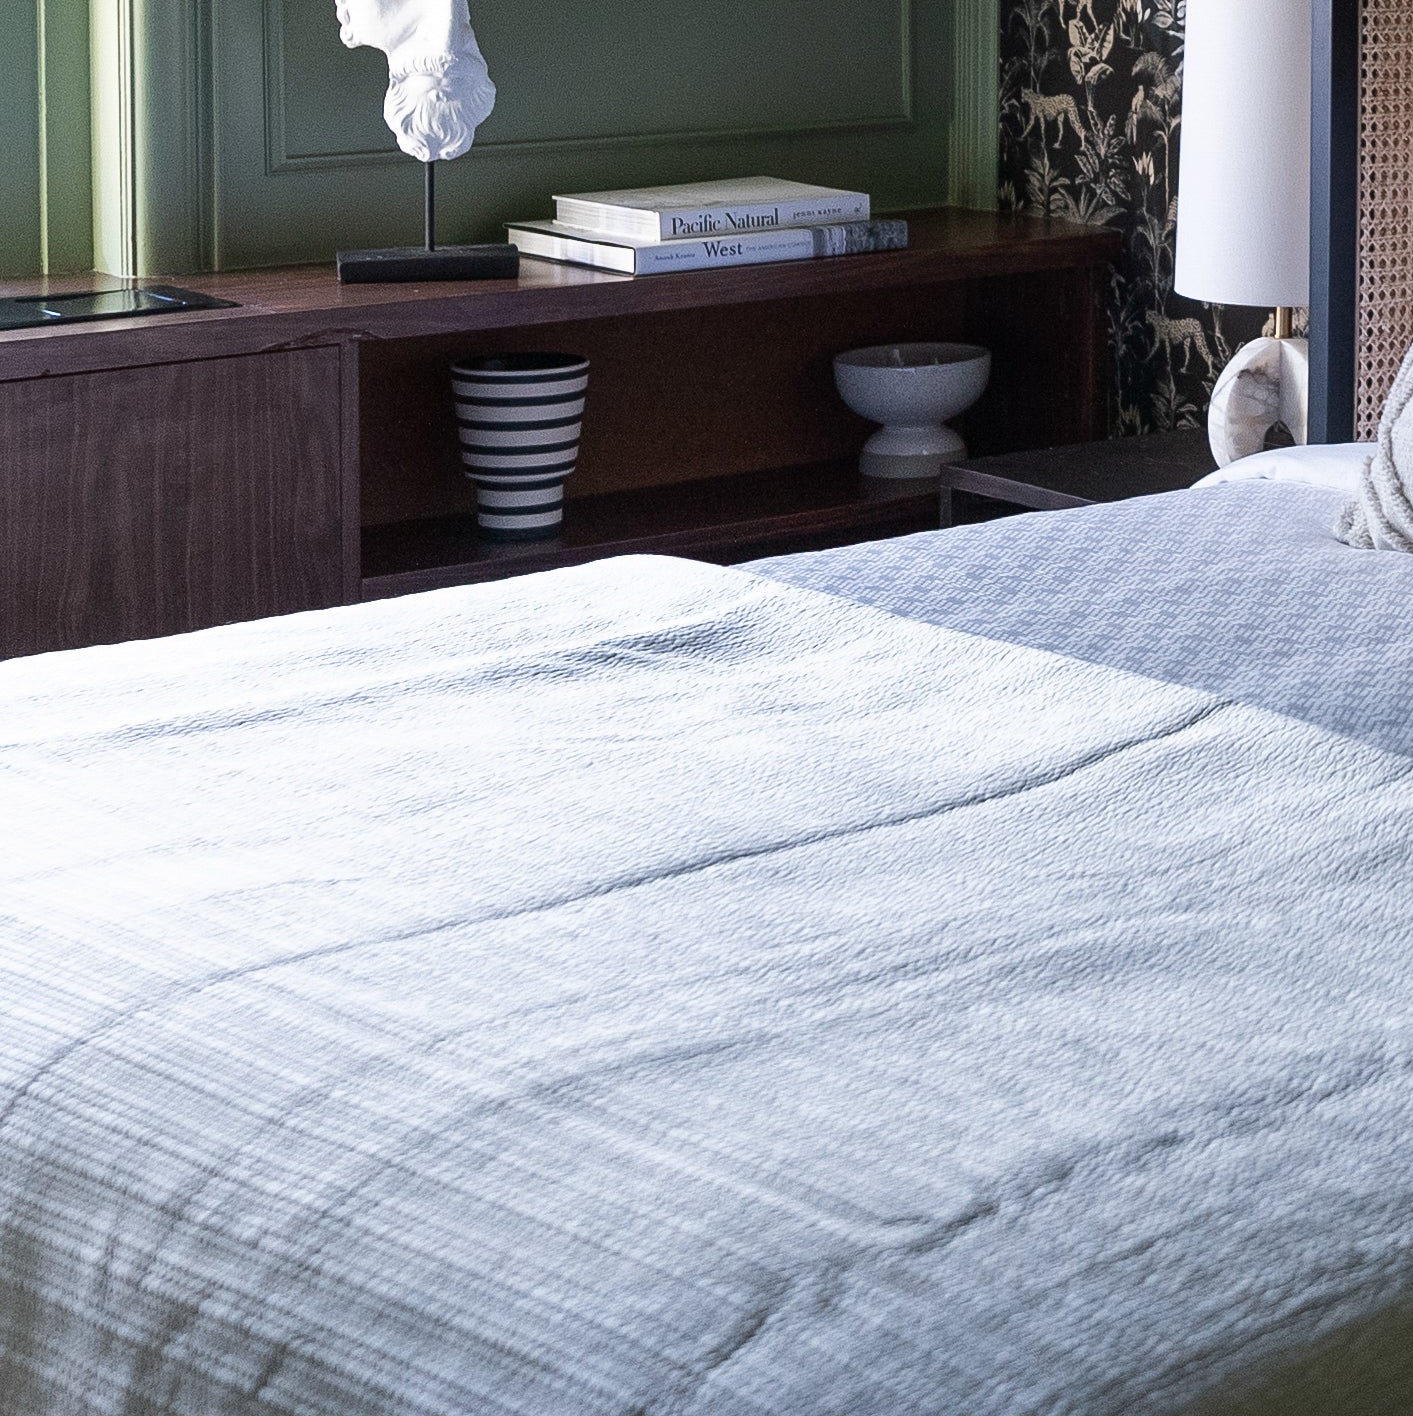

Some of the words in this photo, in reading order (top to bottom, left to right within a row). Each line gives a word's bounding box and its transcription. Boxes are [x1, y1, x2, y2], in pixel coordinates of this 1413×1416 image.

[672, 214, 721, 235] Pacific
[725, 207, 779, 230] Natural
[703, 240, 743, 258] West
